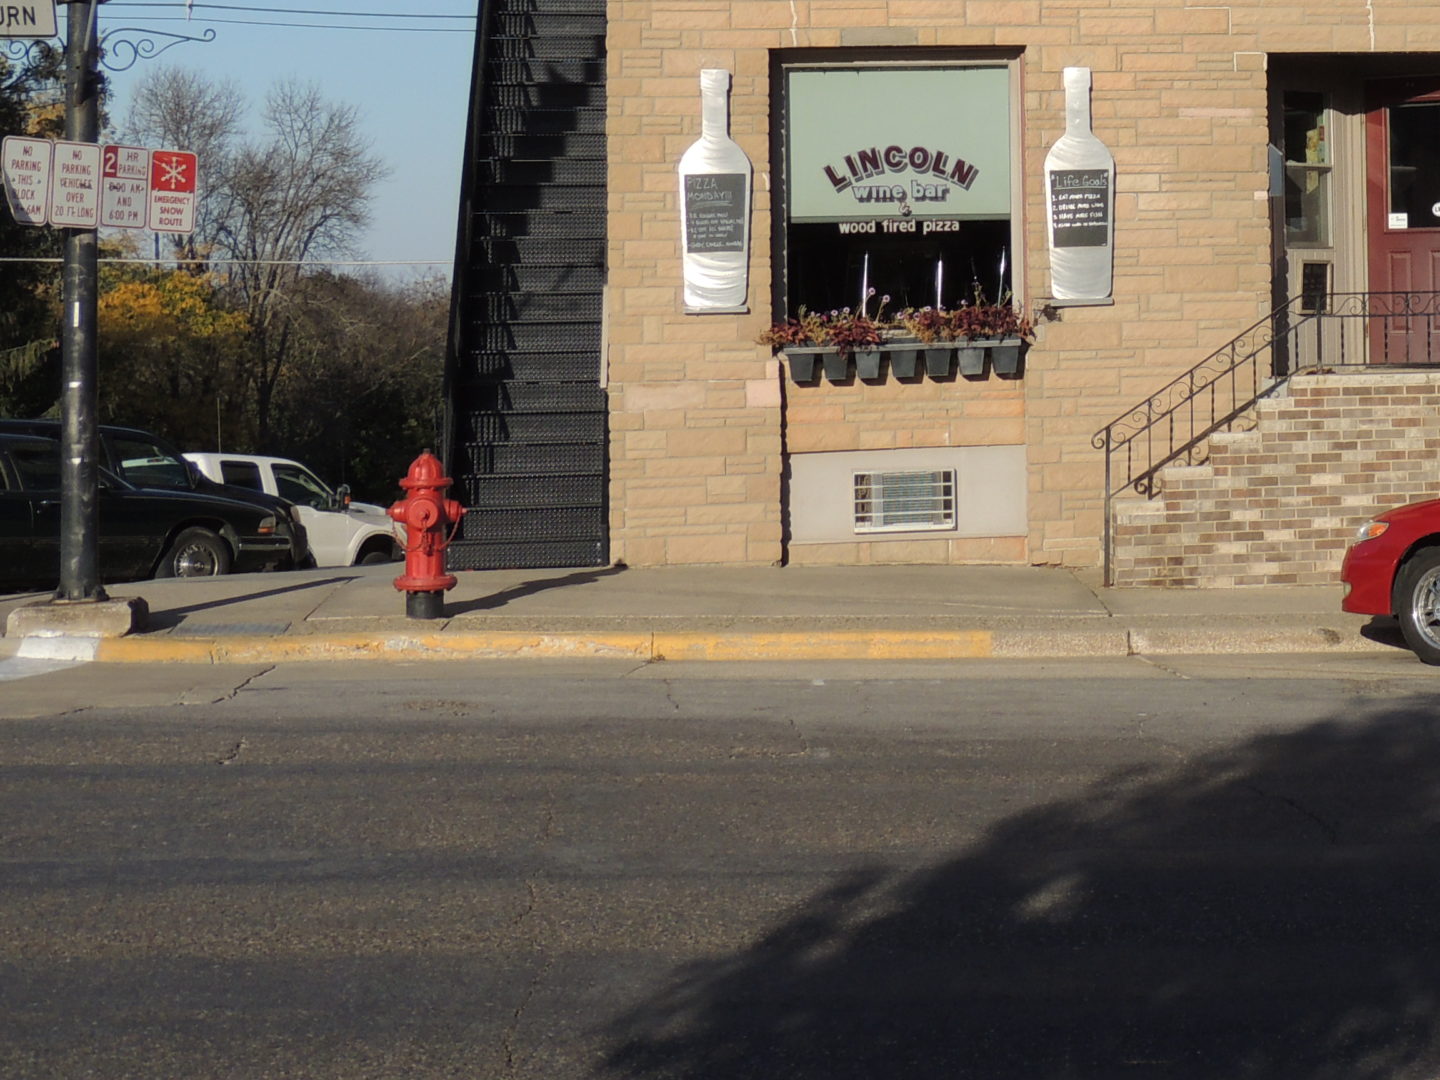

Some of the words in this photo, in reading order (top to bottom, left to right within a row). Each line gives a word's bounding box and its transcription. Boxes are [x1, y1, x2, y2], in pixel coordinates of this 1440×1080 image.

[22, 145, 33, 157] NO
[72, 149, 83, 161] NO
[126, 151, 139, 162] HR
[11, 159, 42, 172] PARKING
[104, 152, 116, 173] 2
[62, 163, 91, 176] PARKING
[118, 163, 146, 176] PARKING
[823, 144, 980, 194] LINCOLN
[17, 174, 33, 185] THIS
[60, 178, 92, 189] VEHICLES
[687, 176, 719, 190] PIZZA
[130, 183, 141, 194] AM
[852, 184, 908, 203] wine
[910, 179, 951, 202] bar
[66, 191, 85, 203] OVER
[117, 196, 132, 207] AND
[154, 195, 190, 205] EMERGENCY
[55, 205, 64, 217] 20
[77, 206, 94, 218] LONG
[128, 210, 138, 221] PM
[159, 206, 184, 216] SNOW
[159, 217, 183, 227] ROUTE
[838, 220, 876, 234] wood
[882, 219, 916, 233] fired
[922, 218, 960, 235] pizza
